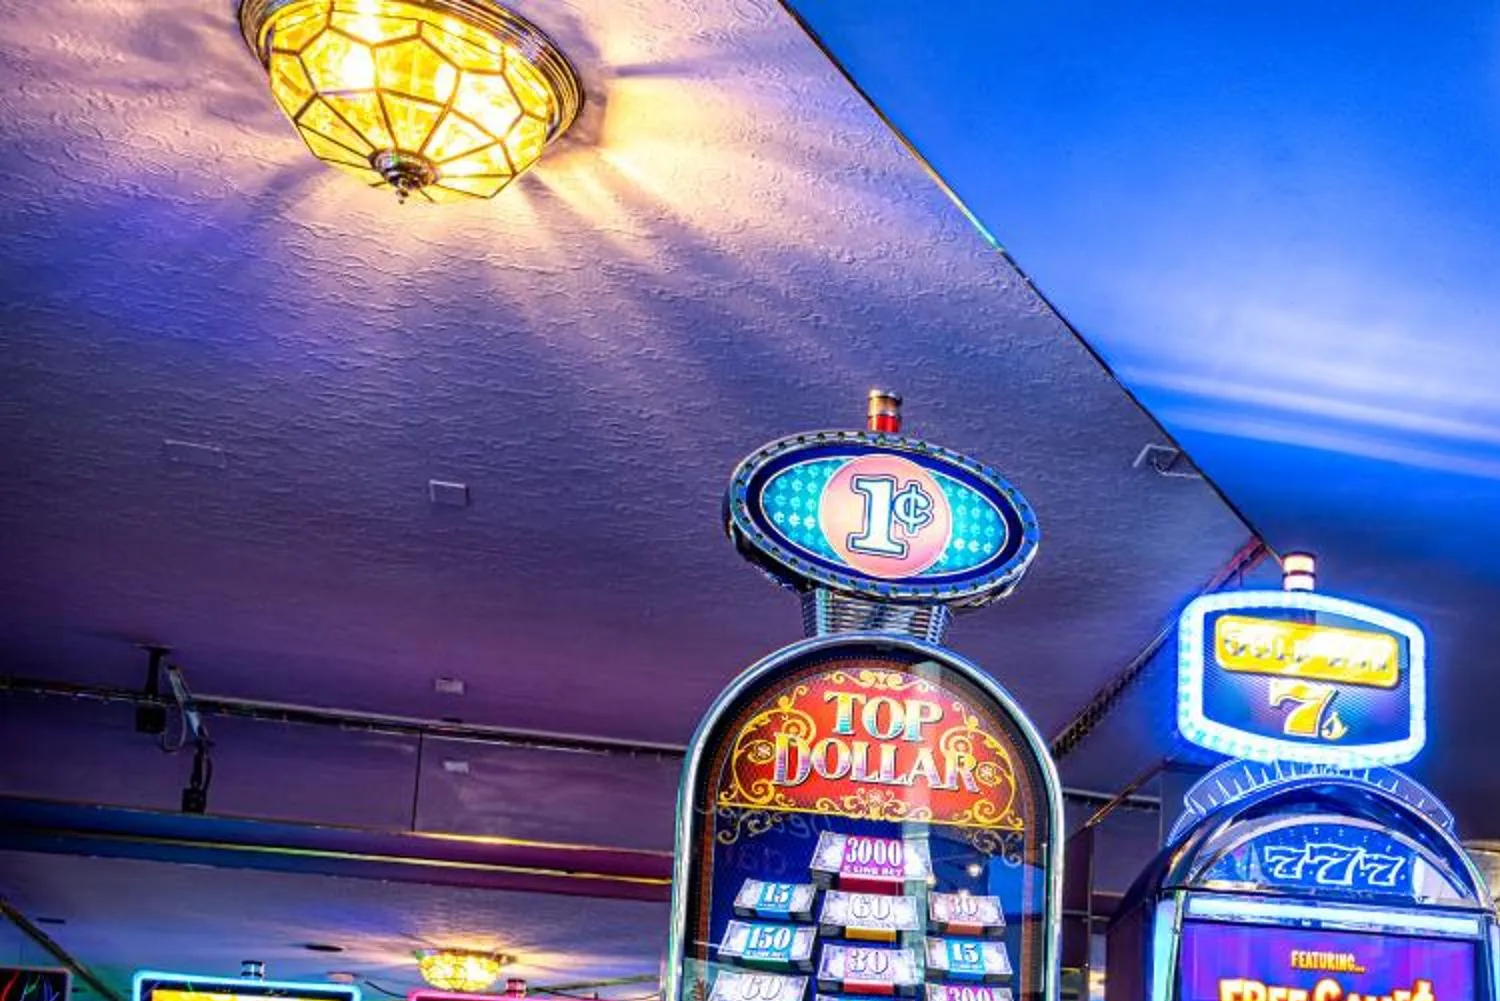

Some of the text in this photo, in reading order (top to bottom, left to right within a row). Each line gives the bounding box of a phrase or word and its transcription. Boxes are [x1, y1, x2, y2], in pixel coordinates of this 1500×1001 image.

[847, 474, 934, 558] 1¢
[823, 691, 944, 743] TOP
[1269, 679, 1349, 741] 7s
[772, 732, 981, 795] DOLLAR
[846, 836, 901, 867] 3000
[764, 883, 790, 904] 15
[850, 895, 892, 921] 60
[751, 926, 793, 951] 150
[850, 950, 890, 975] 30
[953, 943, 980, 965] 15
